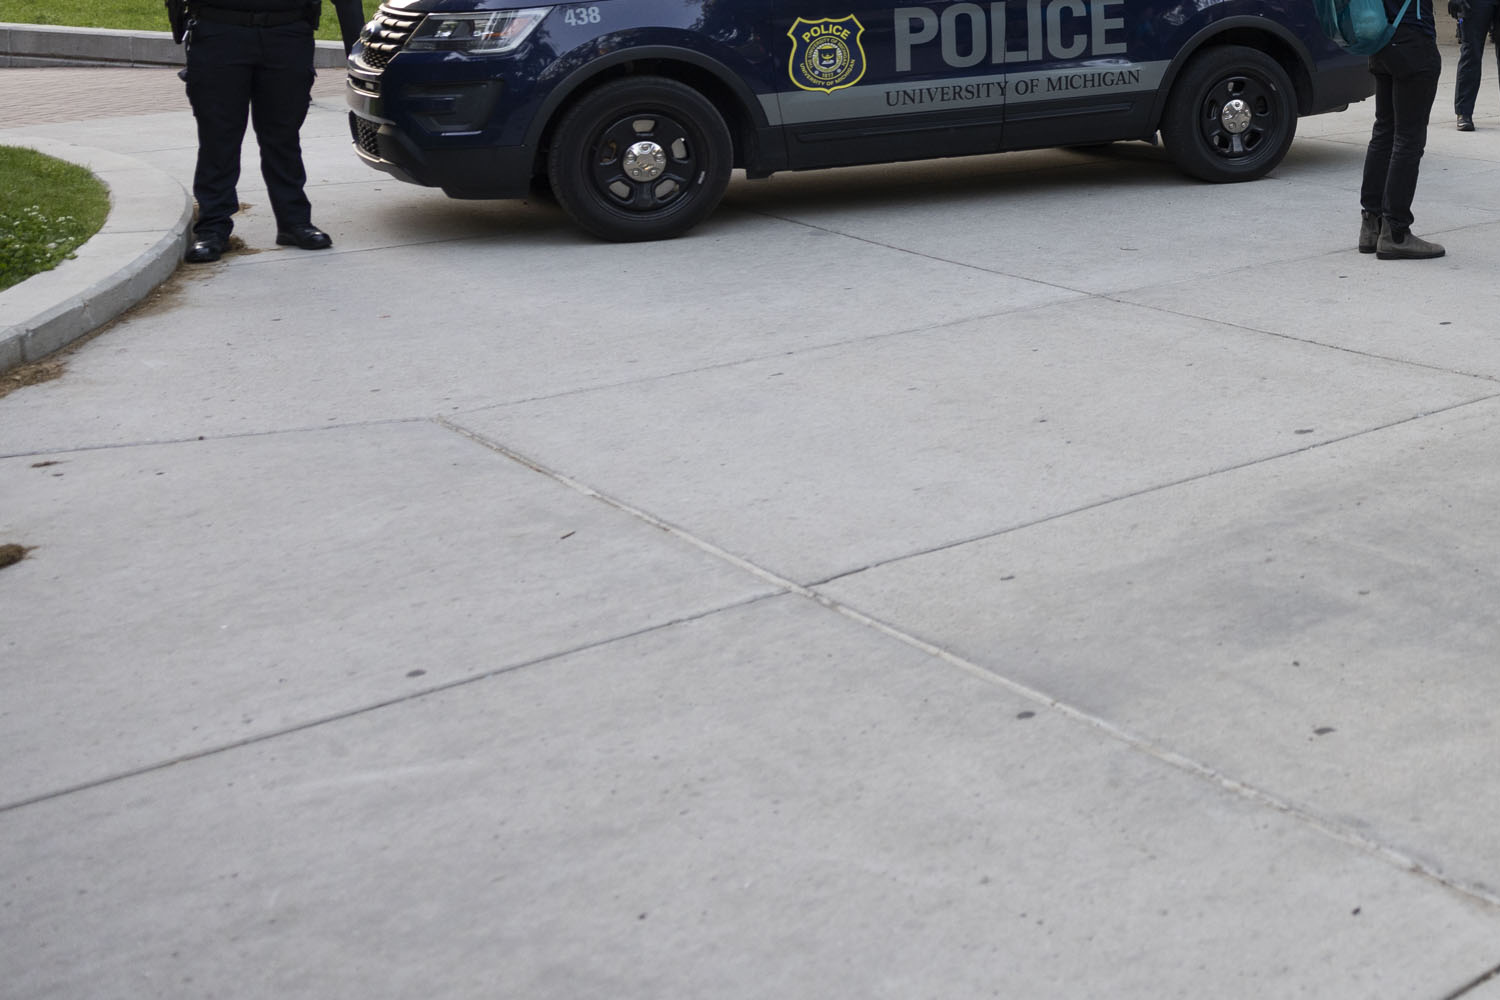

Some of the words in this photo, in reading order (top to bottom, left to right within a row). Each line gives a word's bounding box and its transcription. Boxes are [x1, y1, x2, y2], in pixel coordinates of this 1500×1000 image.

[564, 6, 601, 26] 438
[802, 24, 851, 43] POLICE
[800, 63, 825, 85] UNIVERSITY
[835, 59, 855, 83] MICHIGAN
[885, 80, 1010, 107] UNIVERSITY
[1014, 78, 1040, 96] OF
[1046, 69, 1142, 92] MICHIGAN
